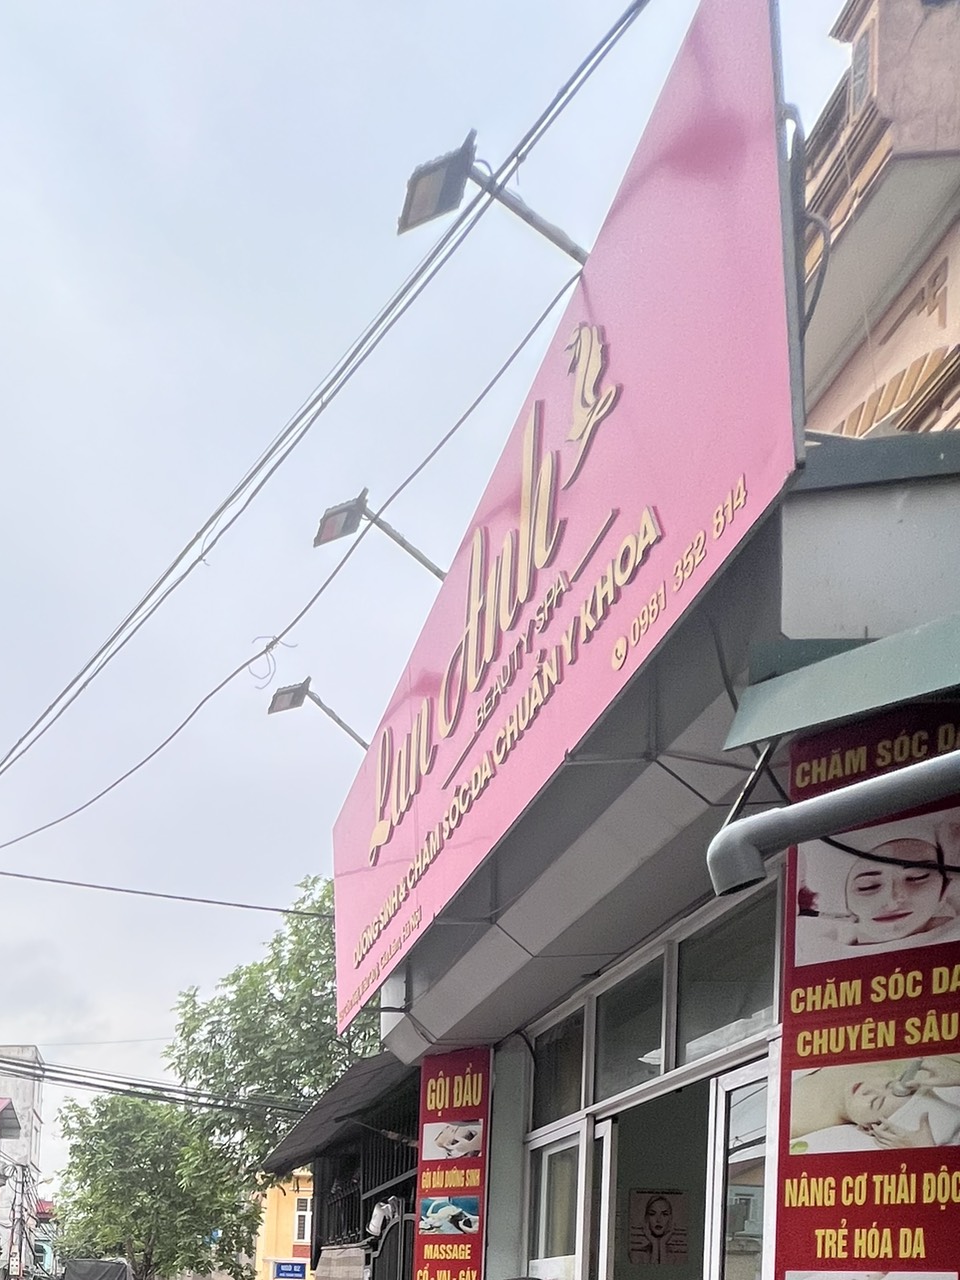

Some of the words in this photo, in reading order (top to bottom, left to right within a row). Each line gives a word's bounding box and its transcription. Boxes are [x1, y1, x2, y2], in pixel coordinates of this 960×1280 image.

[629, 580, 668, 648] 0981
[672, 529, 708, 593] 352
[712, 472, 748, 540] 814
[369, 695, 438, 867] Lan
[437, 398, 568, 740] Anh
[474, 618, 536, 730] BEAUTY
[533, 569, 573, 634] SPA
[379, 885, 402, 931] SINH
[441, 783, 474, 841] SÓC
[469, 750, 498, 802] DA
[493, 645, 564, 765] CHUẨN
[561, 616, 580, 666] Y
[580, 504, 667, 645] KHOA
[795, 745, 867, 788] CHĂM
[875, 729, 929, 768] SÓC
[790, 977, 862, 1014] CHĂM
[870, 967, 923, 1003] SÓC
[796, 1018, 895, 1057] CHUYÊN
[904, 1009, 959, 1045] SÂU
[426, 1070, 450, 1117] GỘI
[784, 1171, 836, 1207] NÂNG
[841, 1172, 868, 1206] CƠ
[872, 1163, 917, 1205] THẢI
[922, 1164, 960, 1211] ĐỘC
[423, 1244, 472, 1260] MASSAGE
[814, 1218, 849, 1259] TRẺ
[853, 1221, 893, 1259] HÓA
[898, 1227, 926, 1259] DA
